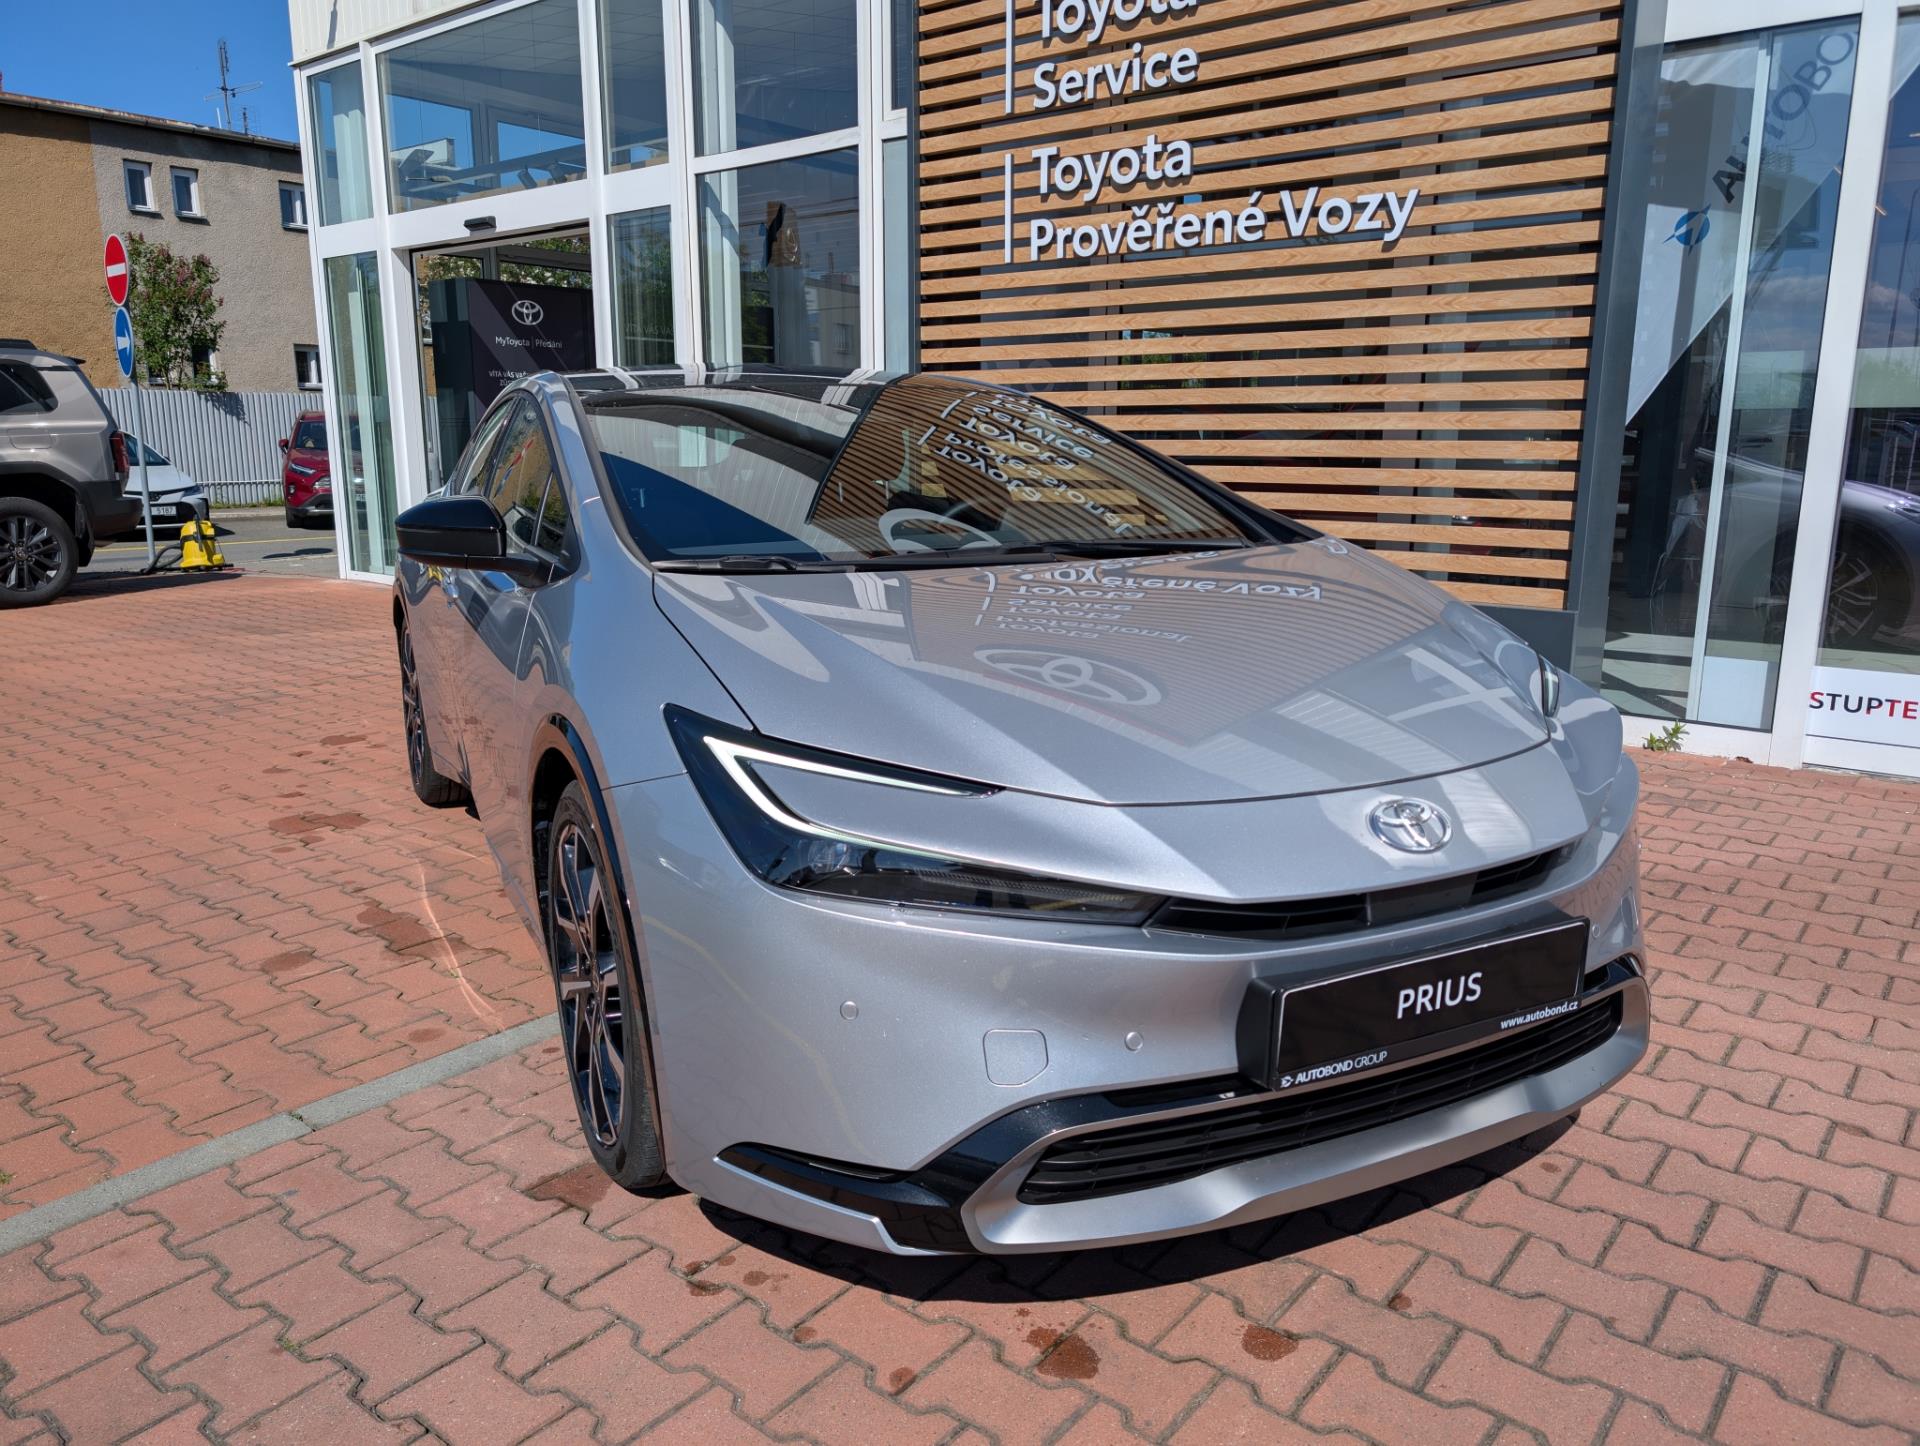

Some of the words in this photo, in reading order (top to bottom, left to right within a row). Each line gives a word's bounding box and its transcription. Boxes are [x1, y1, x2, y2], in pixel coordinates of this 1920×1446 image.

[1041, 0, 1197, 42] Toyo
[1033, 42, 1198, 108] Service
[1032, 134, 1192, 202] Toyota
[1030, 190, 1266, 261] Prověřené
[1279, 186, 1420, 242] Vozy
[495, 336, 530, 347] MyToyota
[1397, 971, 1483, 1019] PRIUS
[1500, 1001, 1580, 1030] www.autobond.cz
[1295, 1060, 1354, 1084] AUTOBOND
[1354, 1051, 1388, 1069] GROUP
